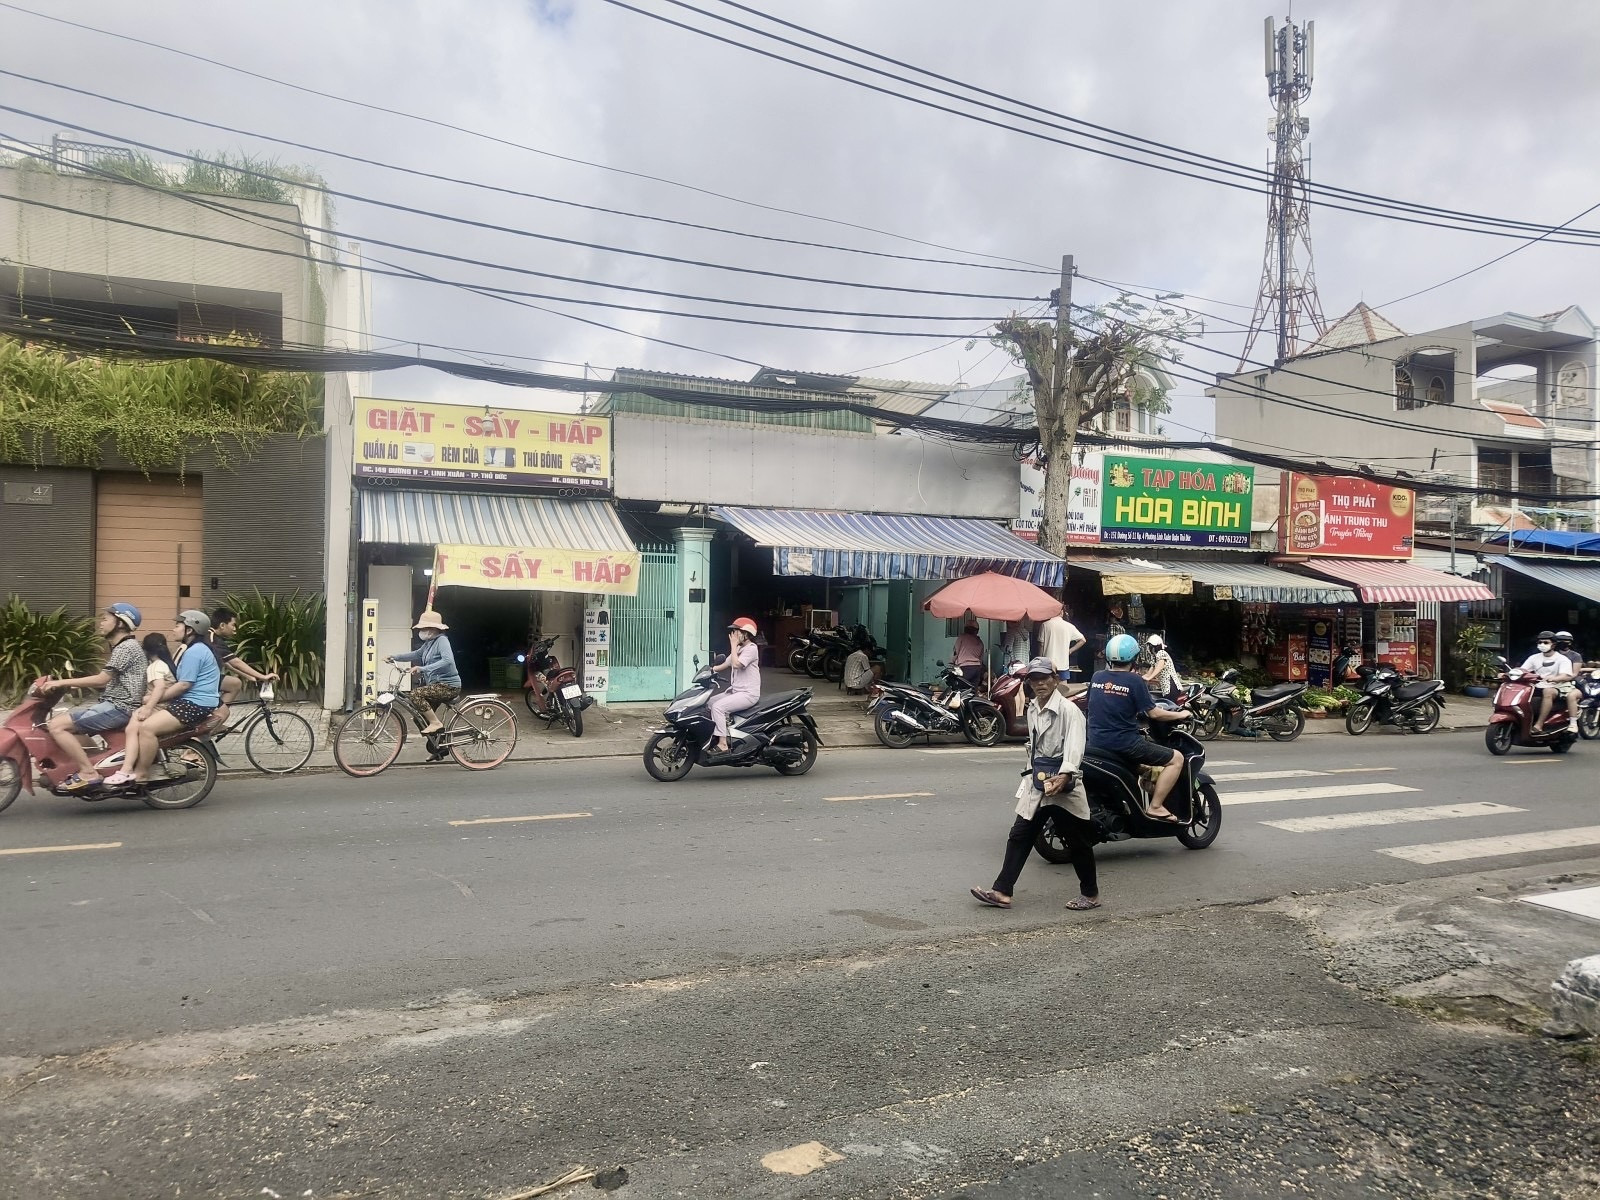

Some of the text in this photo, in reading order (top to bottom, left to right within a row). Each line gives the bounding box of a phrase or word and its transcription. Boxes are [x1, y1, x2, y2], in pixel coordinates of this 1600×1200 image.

[367, 406, 436, 436] GIẶT
[463, 411, 521, 439] SẤY
[548, 418, 603, 445] HẤP
[387, 441, 399, 460] ÁO
[441, 443, 480, 464] RÈM CỬA
[523, 449, 563, 469] THÚ BÔNG
[431, 469, 447, 478] LINH
[1141, 468, 1217, 494] TẠP HÓA
[33, 486, 50, 496] 47
[1115, 491, 1242, 528] HÒA BÌNH
[1332, 494, 1350, 509] THỌ
[1353, 493, 1377, 508] PHÁT
[1344, 515, 1370, 527] TRUNG
[1371, 517, 1388, 528] THU
[1329, 526, 1353, 540] Truyền
[480, 550, 543, 580] SẤY
[572, 555, 632, 585] HẤP
